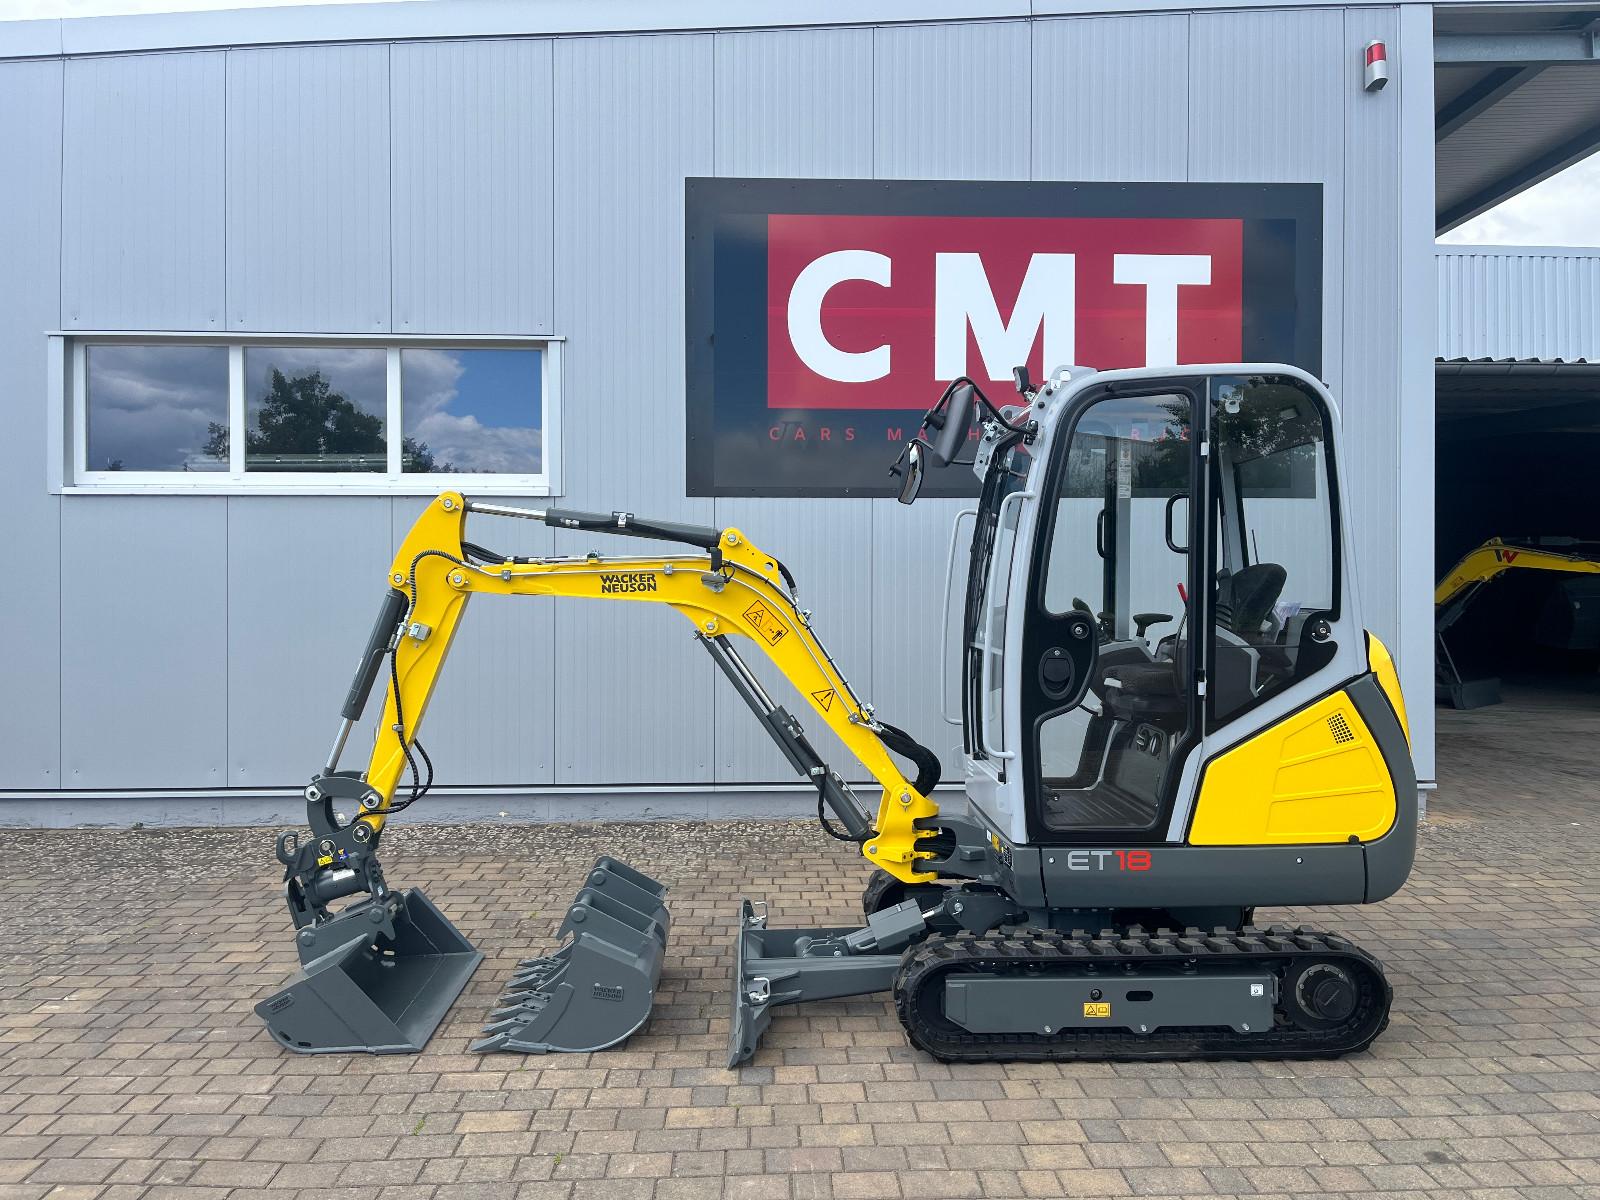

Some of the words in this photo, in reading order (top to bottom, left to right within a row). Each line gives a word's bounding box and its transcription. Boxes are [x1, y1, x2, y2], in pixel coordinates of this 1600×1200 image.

[787, 249, 1212, 382] CMT
[768, 427, 856, 441] CARS
[600, 573, 657, 584] WACKER
[601, 583, 657, 594] NEUSON
[1067, 851, 1152, 871] ET18
